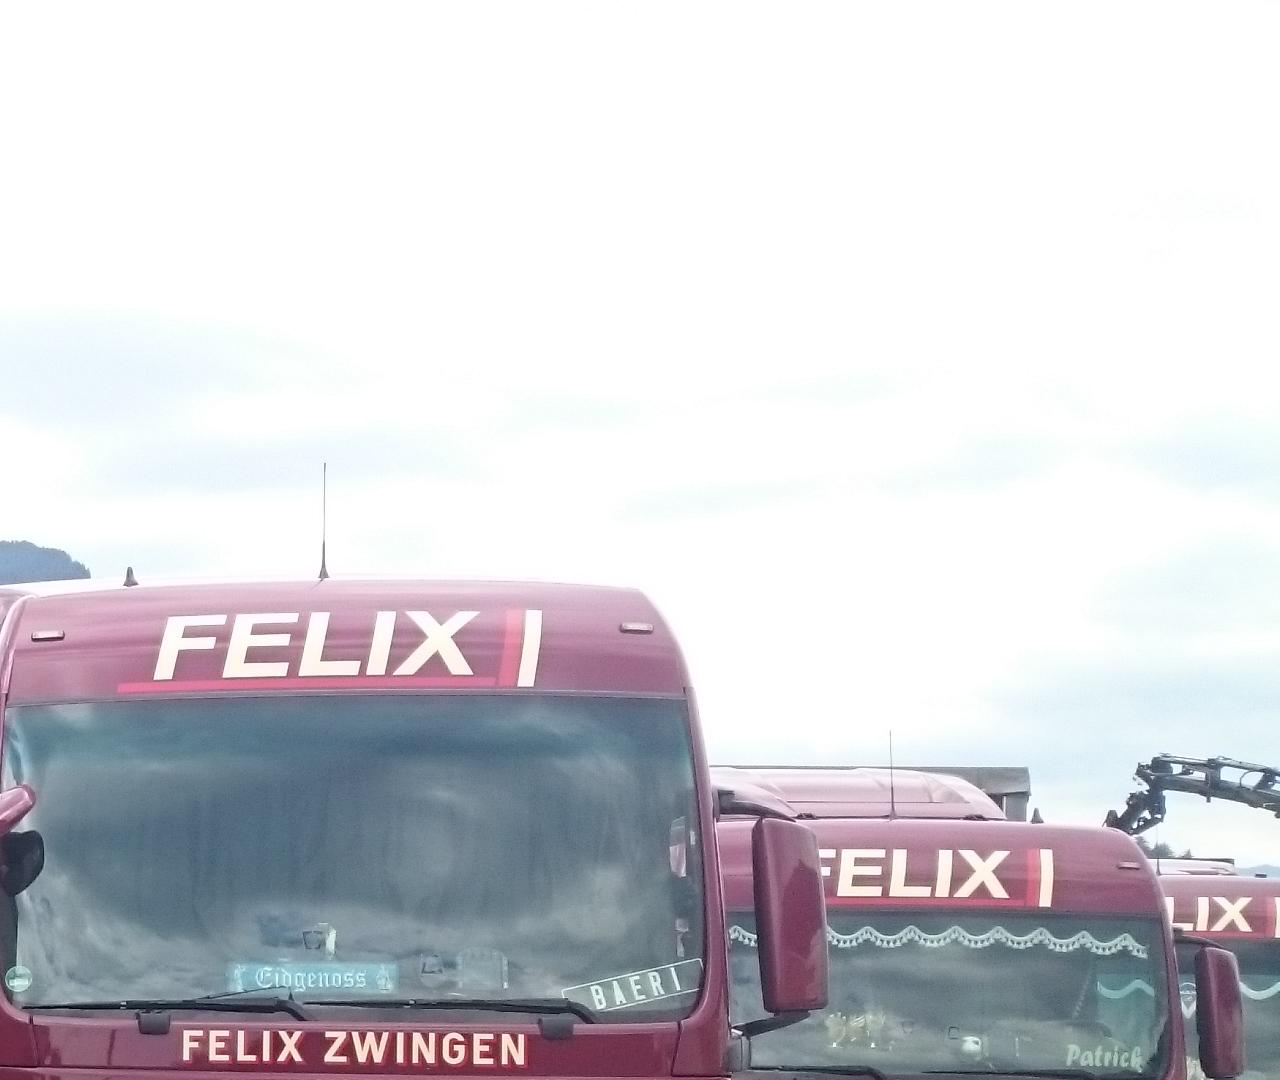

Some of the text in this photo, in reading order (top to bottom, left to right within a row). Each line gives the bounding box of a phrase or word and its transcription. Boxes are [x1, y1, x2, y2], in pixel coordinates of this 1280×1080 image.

[153, 609, 481, 680] FELIX
[1165, 896, 1253, 932] LIX
[255, 966, 368, 992] Eidgenoss
[590, 966, 681, 1010] BAERI
[182, 1030, 526, 1065] FELIX ZWINGEN
[1065, 1044, 1144, 1072] Patrick
